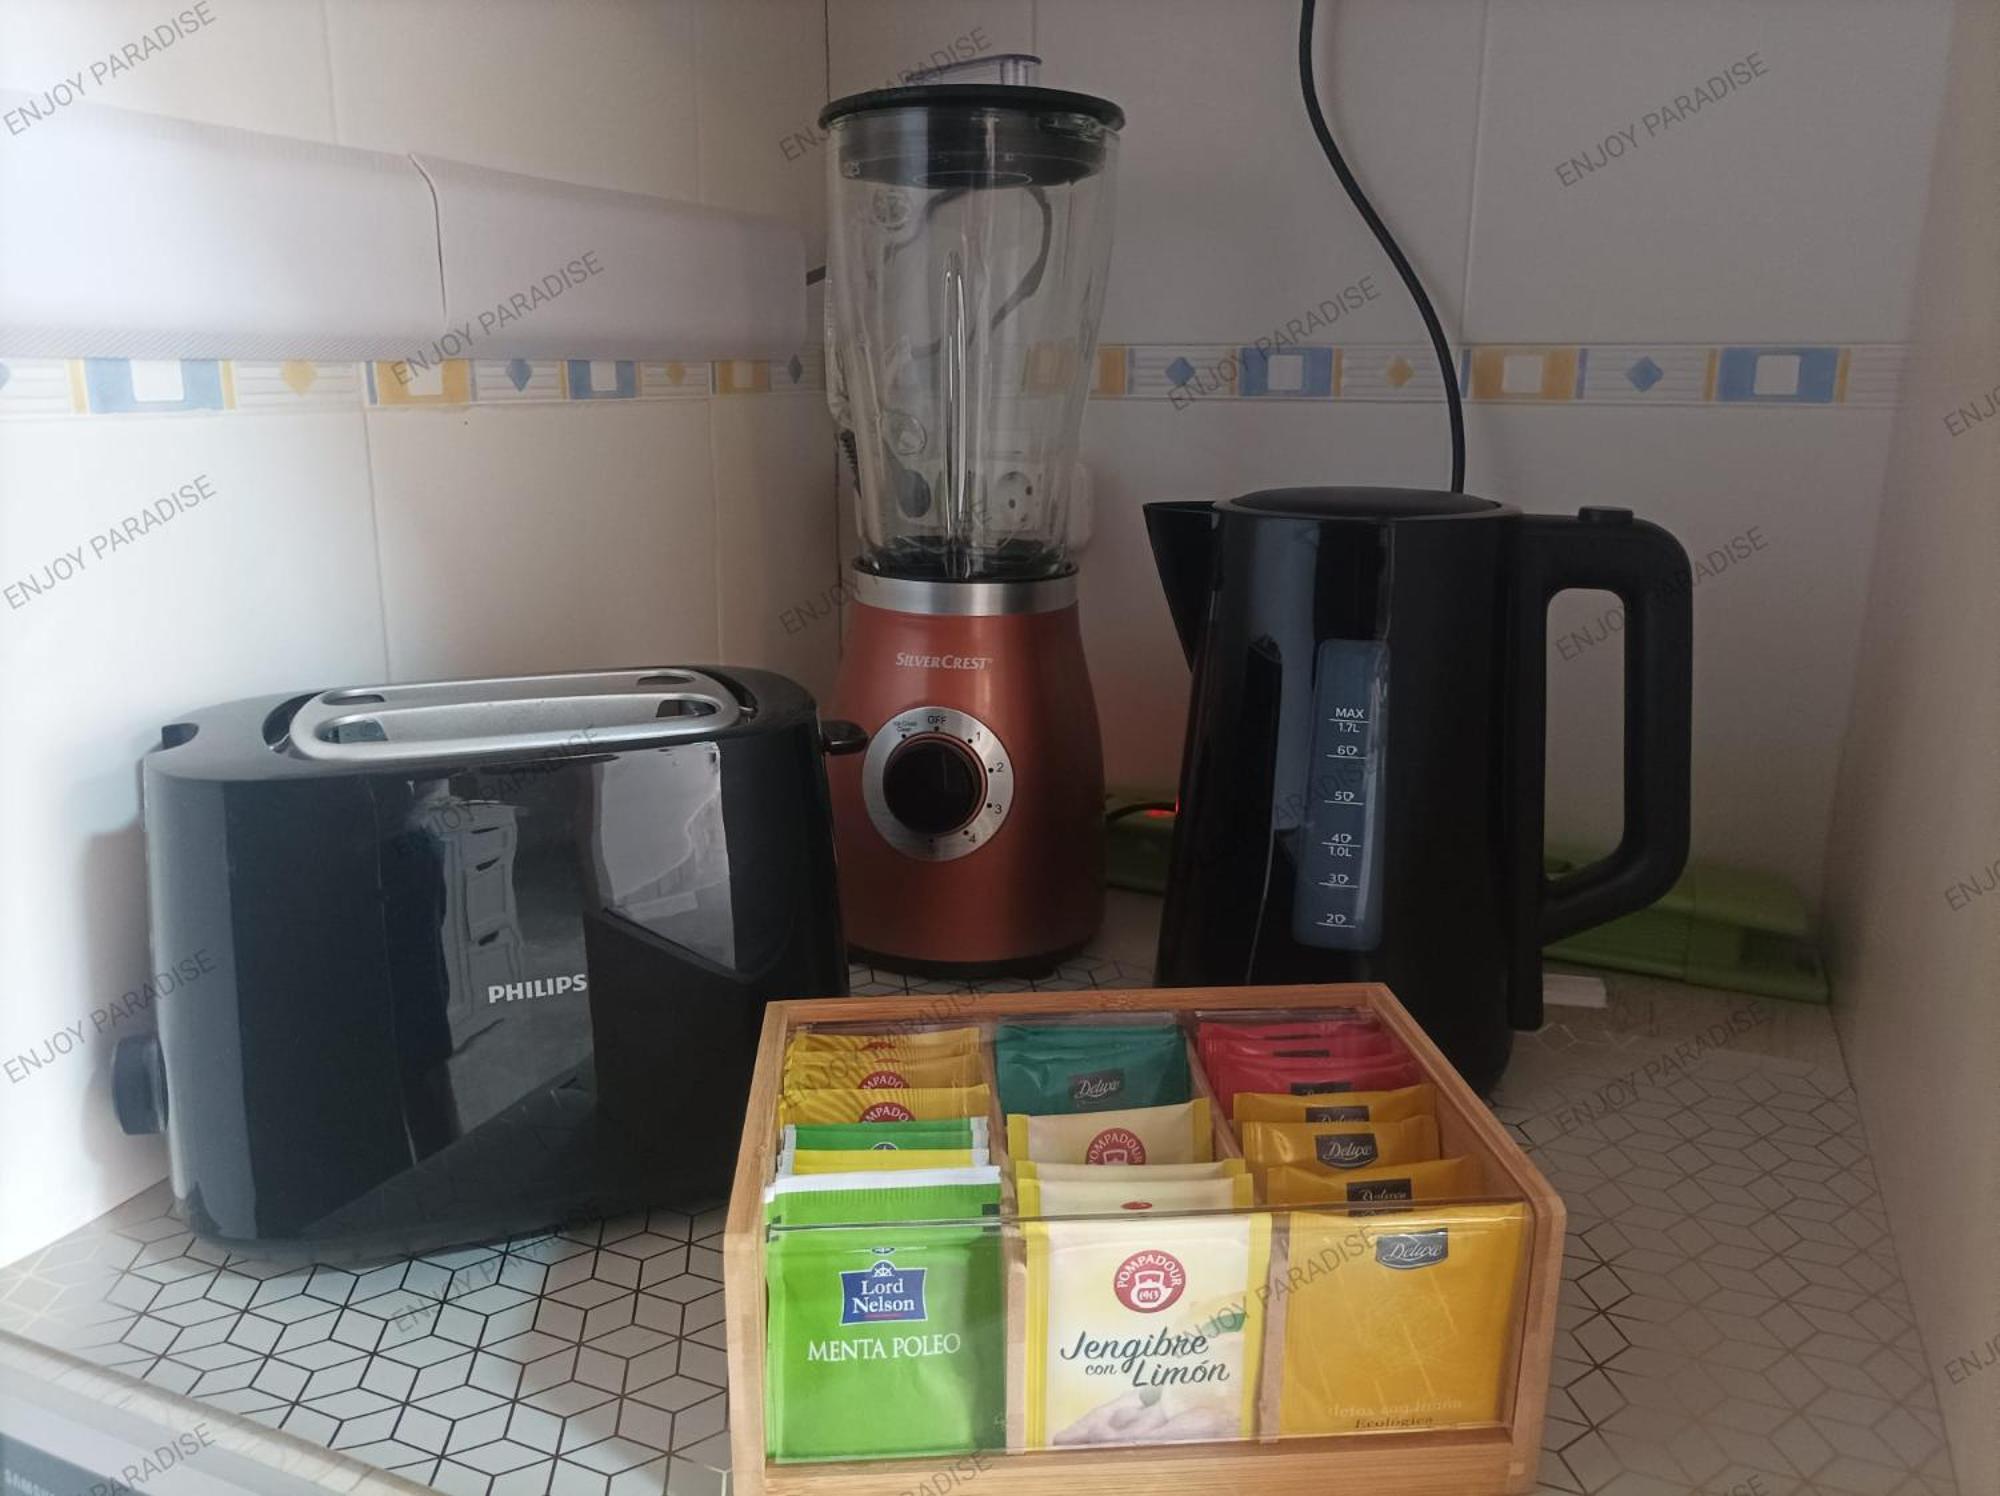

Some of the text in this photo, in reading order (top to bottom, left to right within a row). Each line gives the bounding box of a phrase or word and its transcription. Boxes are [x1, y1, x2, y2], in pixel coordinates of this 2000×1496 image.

[928, 715, 946, 726] OFF
[1335, 707, 1365, 719] MAX
[1339, 722, 1360, 733] 1.7L
[996, 761, 1005, 773] 2
[994, 803, 1003, 815] 3
[968, 834, 977, 844] 4
[488, 973, 587, 1004] PHILIPS
[1382, 1241, 1442, 1262] Deluxe
[1116, 1254, 1184, 1289] POMPADOUR
[861, 1278, 904, 1296] Lord
[852, 1296, 915, 1314] Nelson
[808, 1333, 960, 1361] MENTA POLEO
[1060, 1325, 1209, 1374] Jengibre
[1085, 1359, 1230, 1387] con Limón
